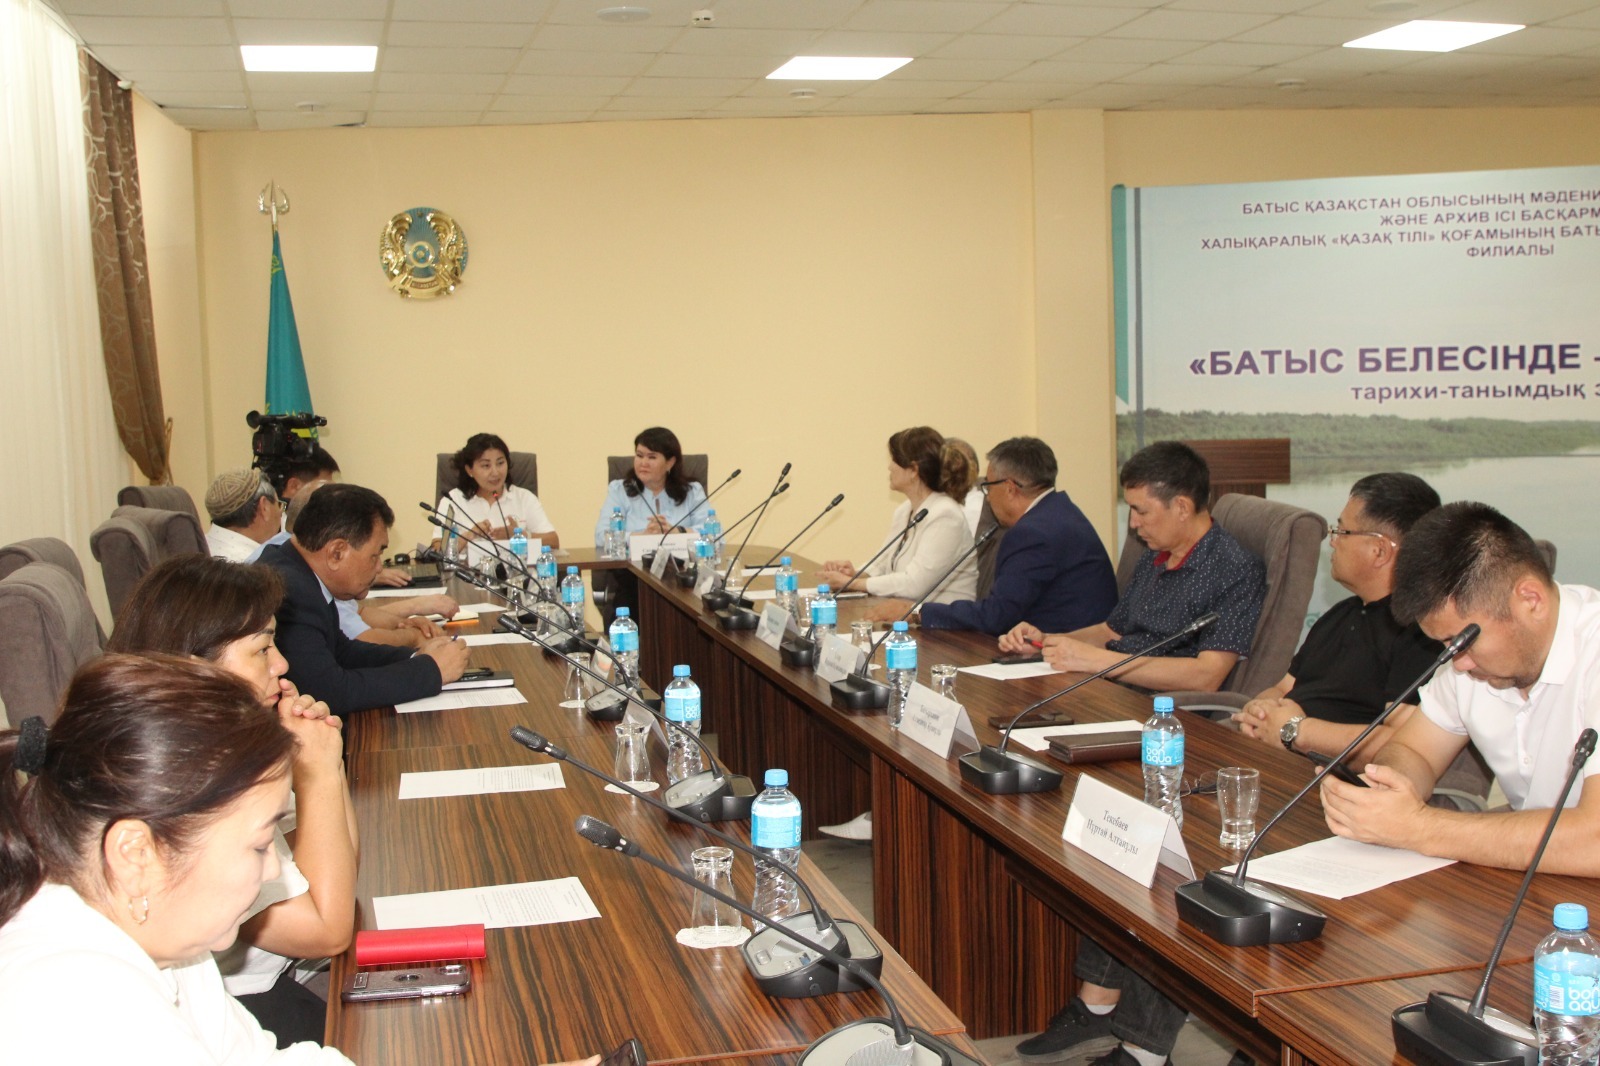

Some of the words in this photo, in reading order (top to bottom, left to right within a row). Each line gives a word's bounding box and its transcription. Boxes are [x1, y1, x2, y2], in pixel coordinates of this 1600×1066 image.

[1242, 201, 1300, 215] БАТЫС
[1305, 198, 1401, 213] ҚАЗАҚСТАН
[1406, 193, 1525, 209] ОБЛЫСЫНЫҢ
[1380, 213, 1428, 226] ЖӘНЕ
[1434, 211, 1490, 224] АРХИВ
[1495, 210, 1516, 222] ІСІ
[1201, 235, 1327, 249] ХАЛЫҚАРАЛЫҚ
[1331, 232, 1393, 246] «ҚАЗАҚ
[1399, 230, 1435, 243] ТІЛІ»
[1441, 226, 1555, 241] ҚОҒАМЫНЫҢ
[1467, 244, 1554, 258] ФИЛИАЛЫ
[1189, 348, 1344, 376] «БАТЫС
[1359, 344, 1581, 375] БЕЛЕСІНДЕ
[1351, 383, 1586, 404] тарихи-танымдық
[1146, 746, 1165, 755] bon
[1146, 755, 1172, 764] aqua
